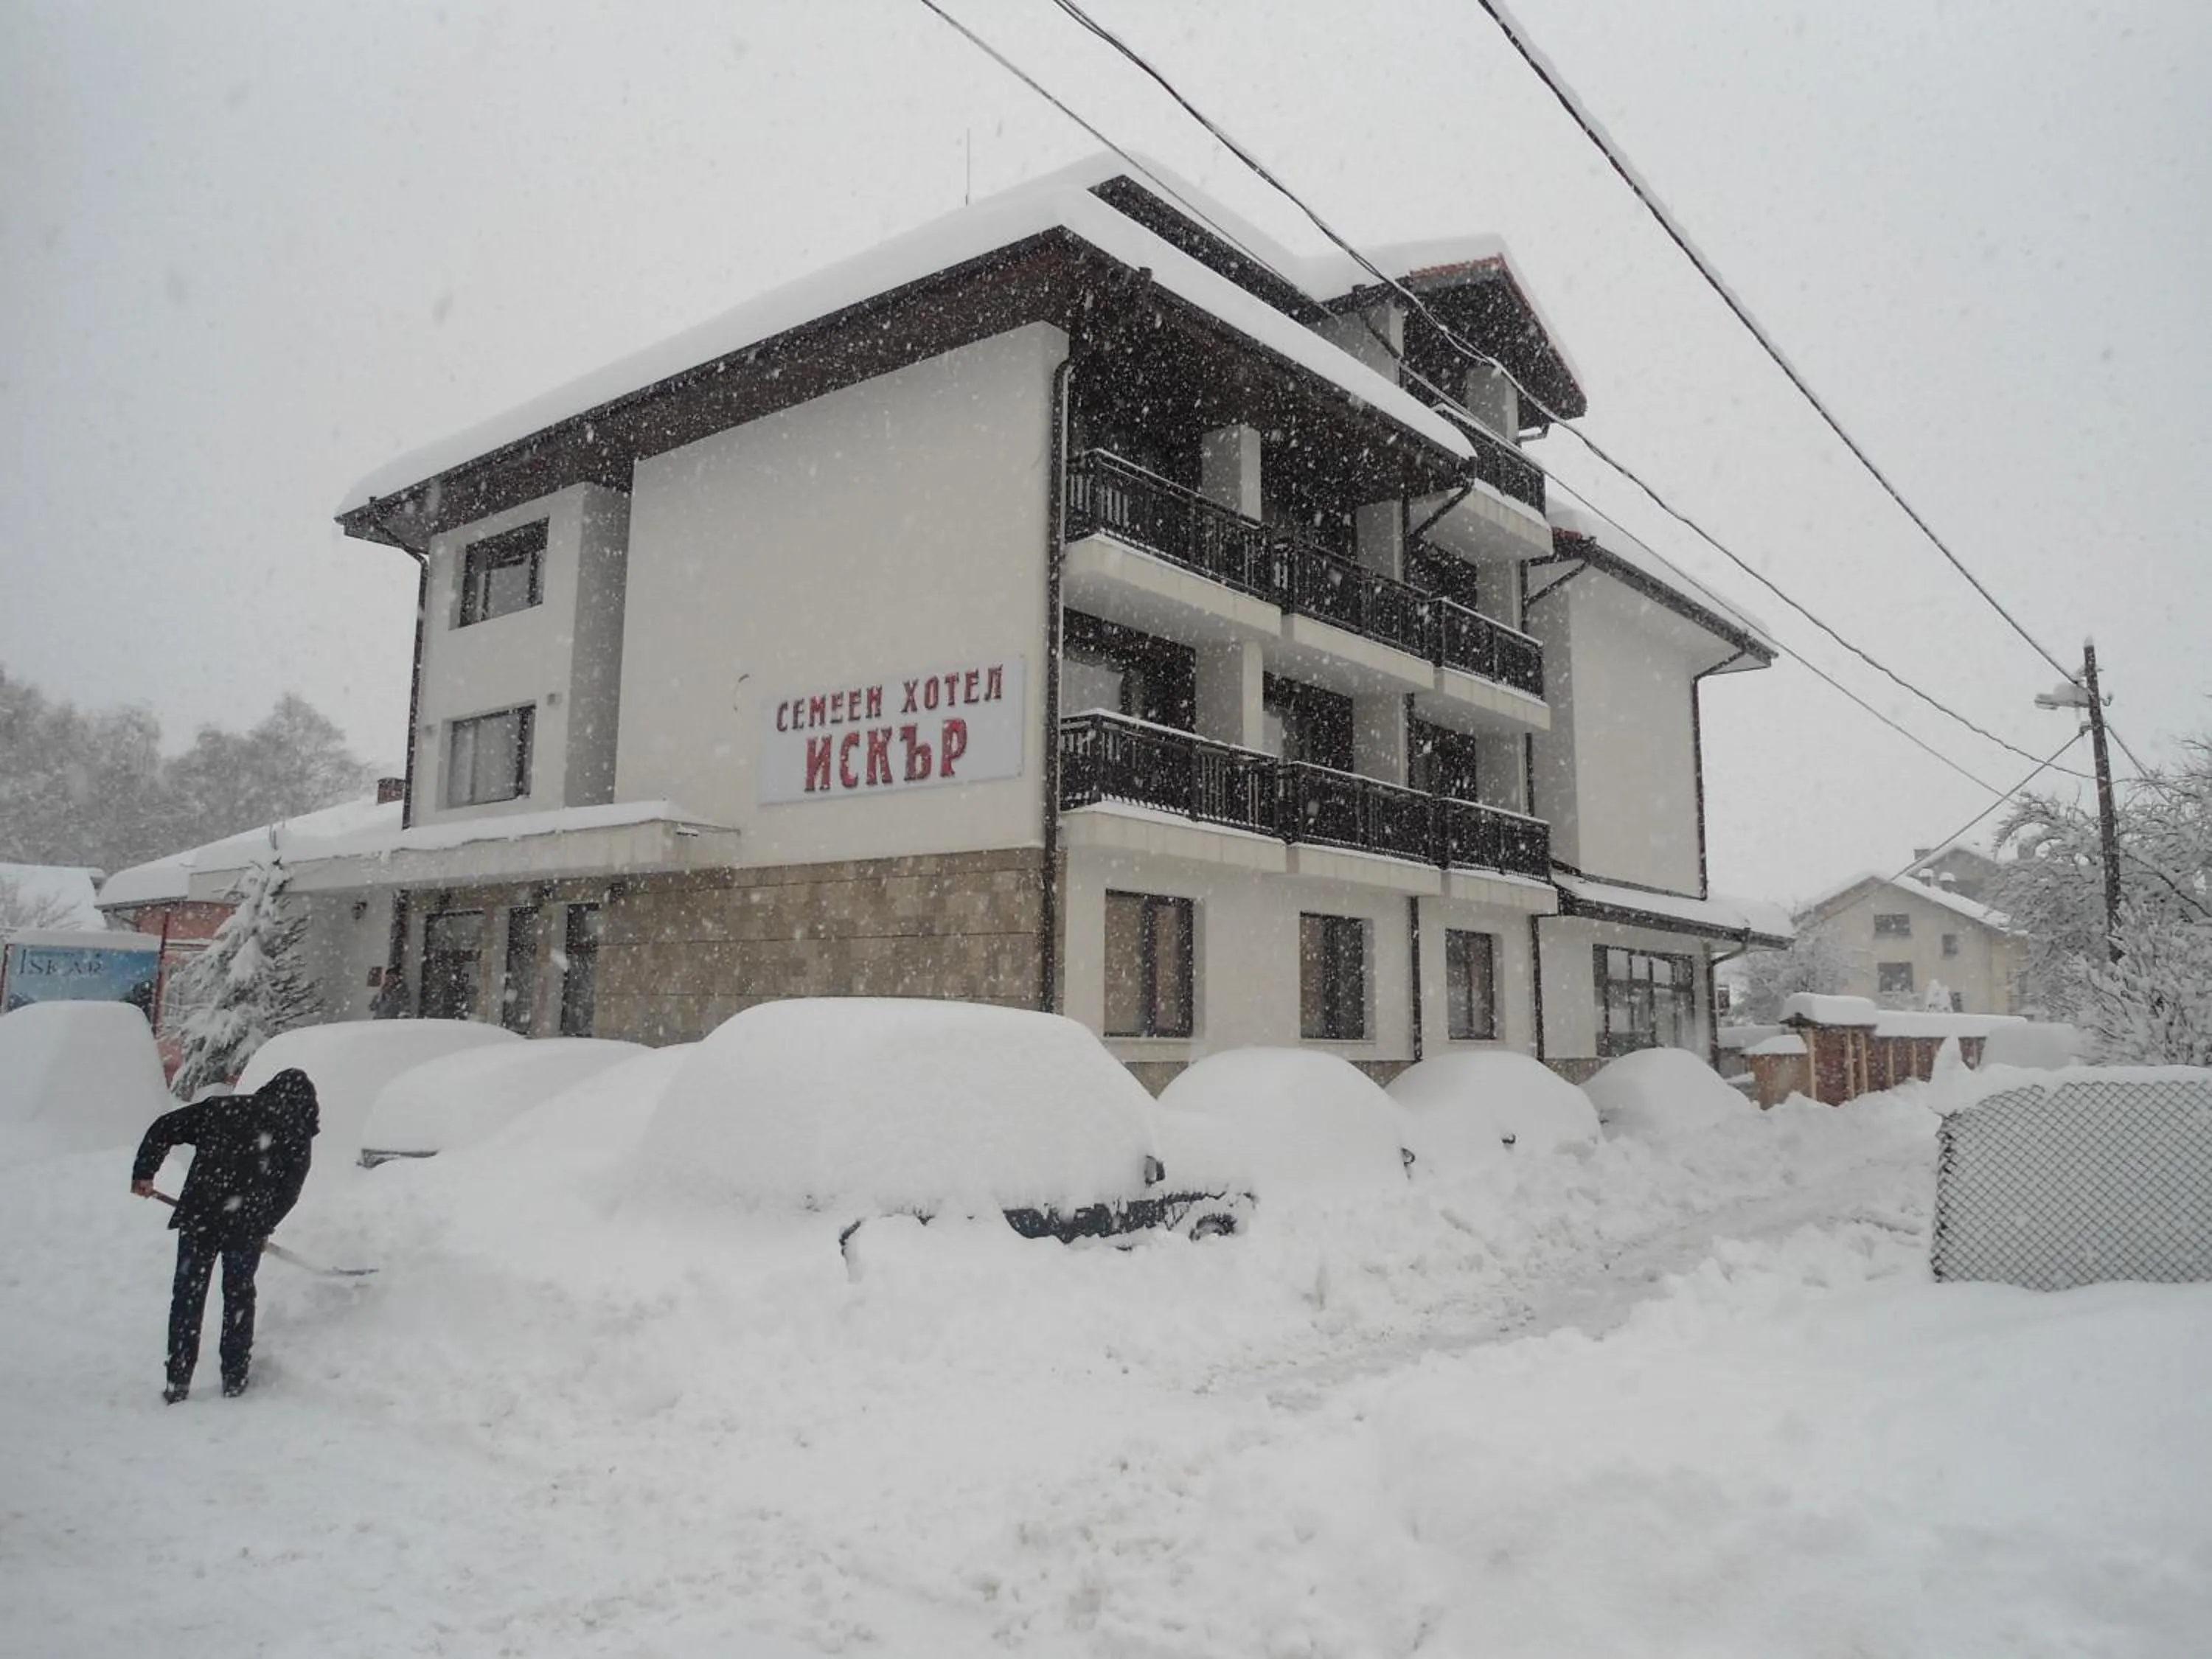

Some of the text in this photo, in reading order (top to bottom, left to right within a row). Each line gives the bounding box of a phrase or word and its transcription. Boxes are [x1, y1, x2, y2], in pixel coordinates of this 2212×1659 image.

[776, 664, 1004, 732] СЕМЕЕН ХОТЕЛ
[804, 718, 967, 792] ИСКЪР
